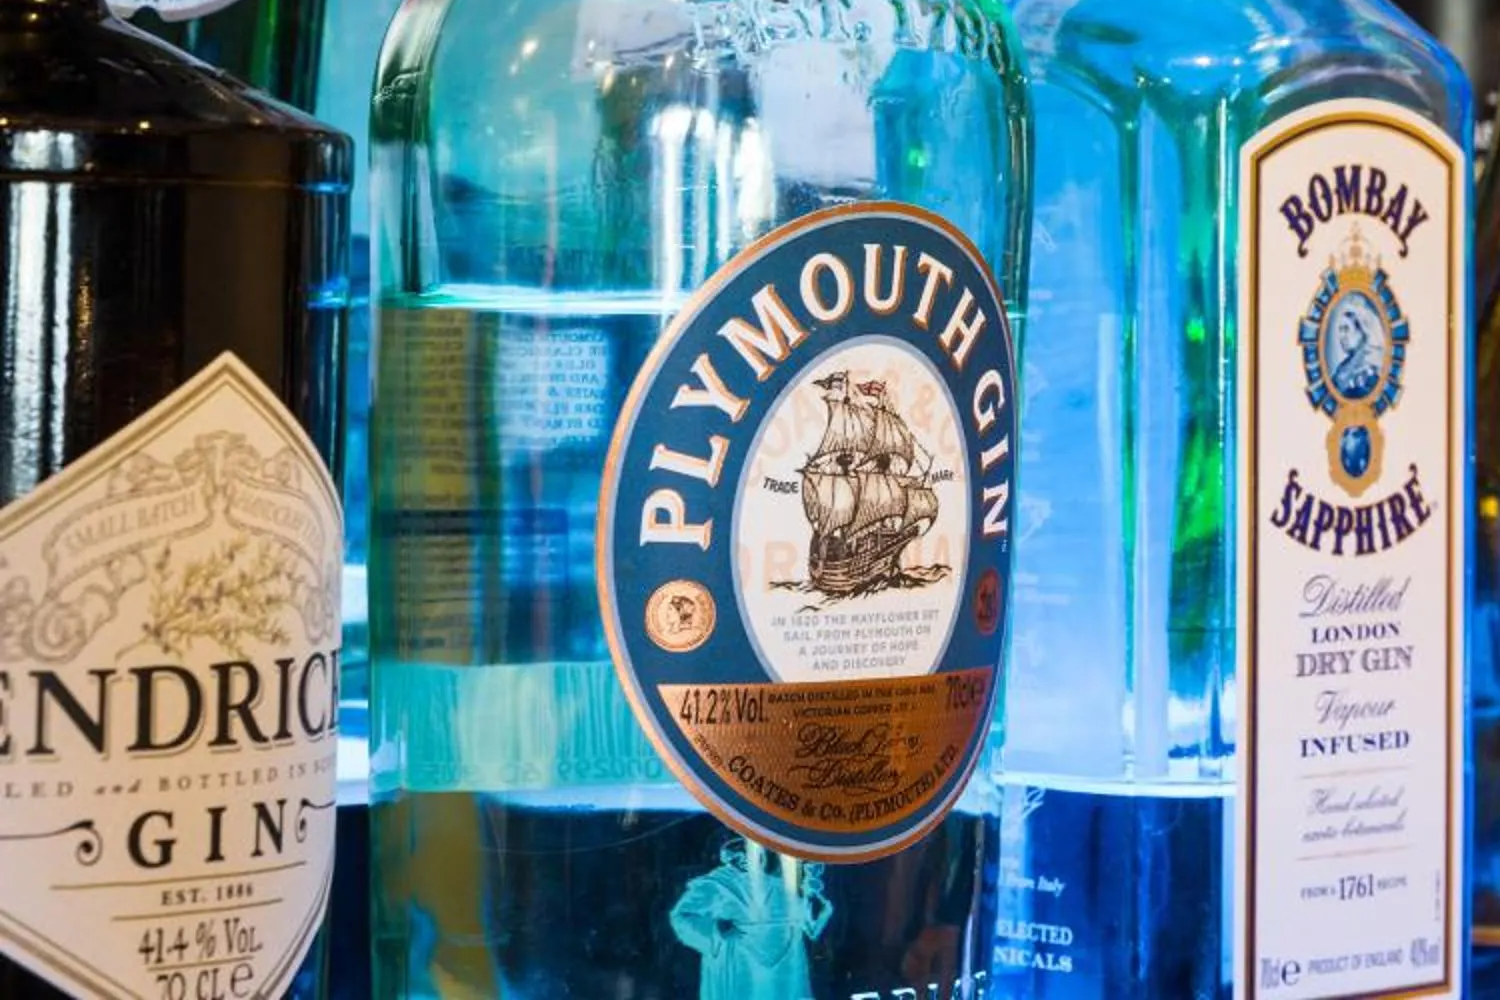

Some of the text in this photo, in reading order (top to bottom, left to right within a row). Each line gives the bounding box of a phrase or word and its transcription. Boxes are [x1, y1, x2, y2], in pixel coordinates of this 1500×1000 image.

[1279, 164, 1428, 258] BOMBAY
[639, 243, 986, 552] PLYMOUTH
[973, 369, 1010, 537] GIN
[763, 476, 798, 494] TRADE
[1269, 462, 1432, 557] SAPPHIRE
[1298, 574, 1412, 618] Distilled
[824, 614, 846, 626] THE
[851, 612, 918, 625] MAYFLOWER
[1311, 621, 1401, 644] LONDON
[784, 626, 931, 642] SAIL FROM PLYMOUTH ON
[812, 643, 868, 656] JOURNEY
[871, 642, 886, 653] OF
[891, 640, 918, 651] HOPE
[812, 656, 906, 670] AND DISCOVERY
[1296, 645, 1414, 678] DRY GIN
[1301, 729, 1409, 758] INFUSED
[93, 778, 141, 794] and
[158, 766, 279, 792] BOTTLED
[802, 800, 817, 817] &
[127, 799, 288, 869] GIN
[161, 887, 207, 906] EST.
[1339, 873, 1374, 901] 1761
